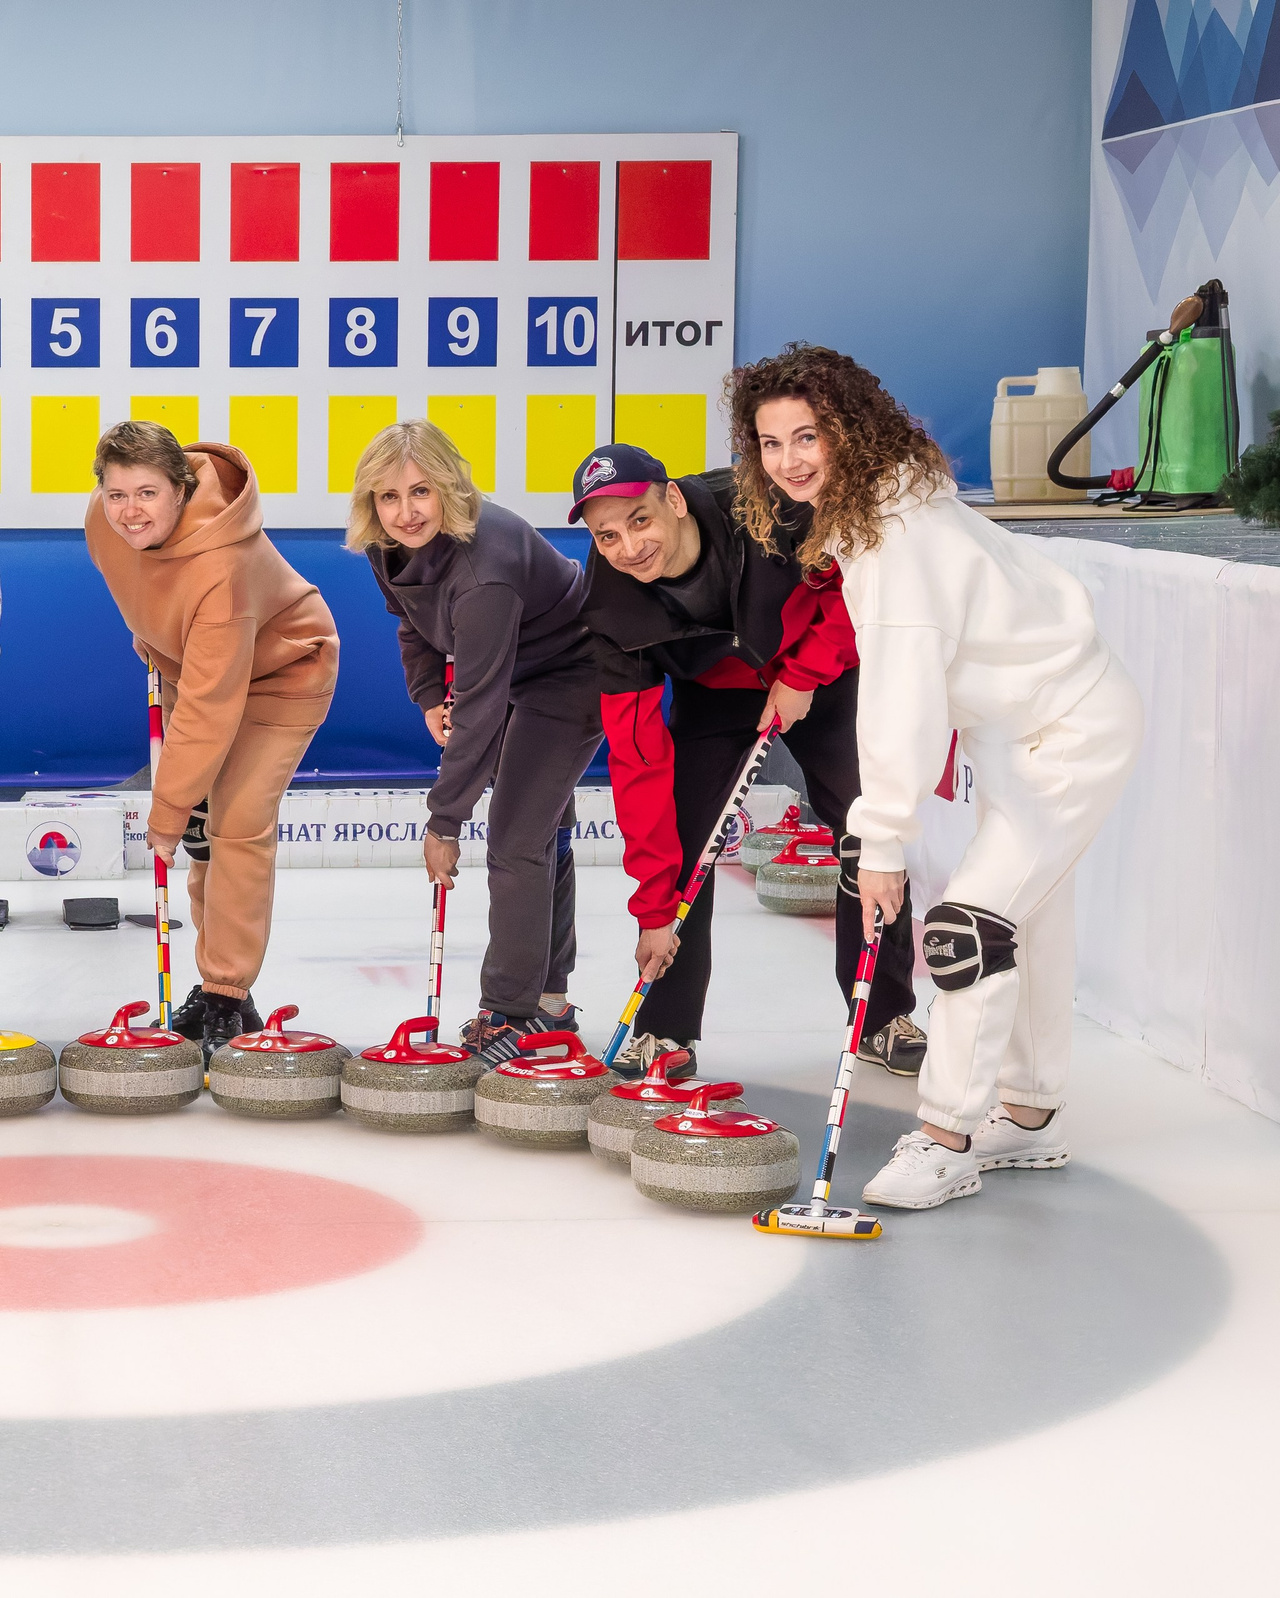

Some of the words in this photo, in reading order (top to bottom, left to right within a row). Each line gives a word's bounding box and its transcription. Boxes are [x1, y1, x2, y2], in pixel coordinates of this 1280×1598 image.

[49, 307, 82, 357] 5
[145, 307, 178, 357] 6
[244, 307, 277, 356] 7
[344, 306, 377, 357] 8
[447, 306, 480, 356] 9
[535, 306, 596, 356] 10
[277, 823, 326, 842] НАТ
